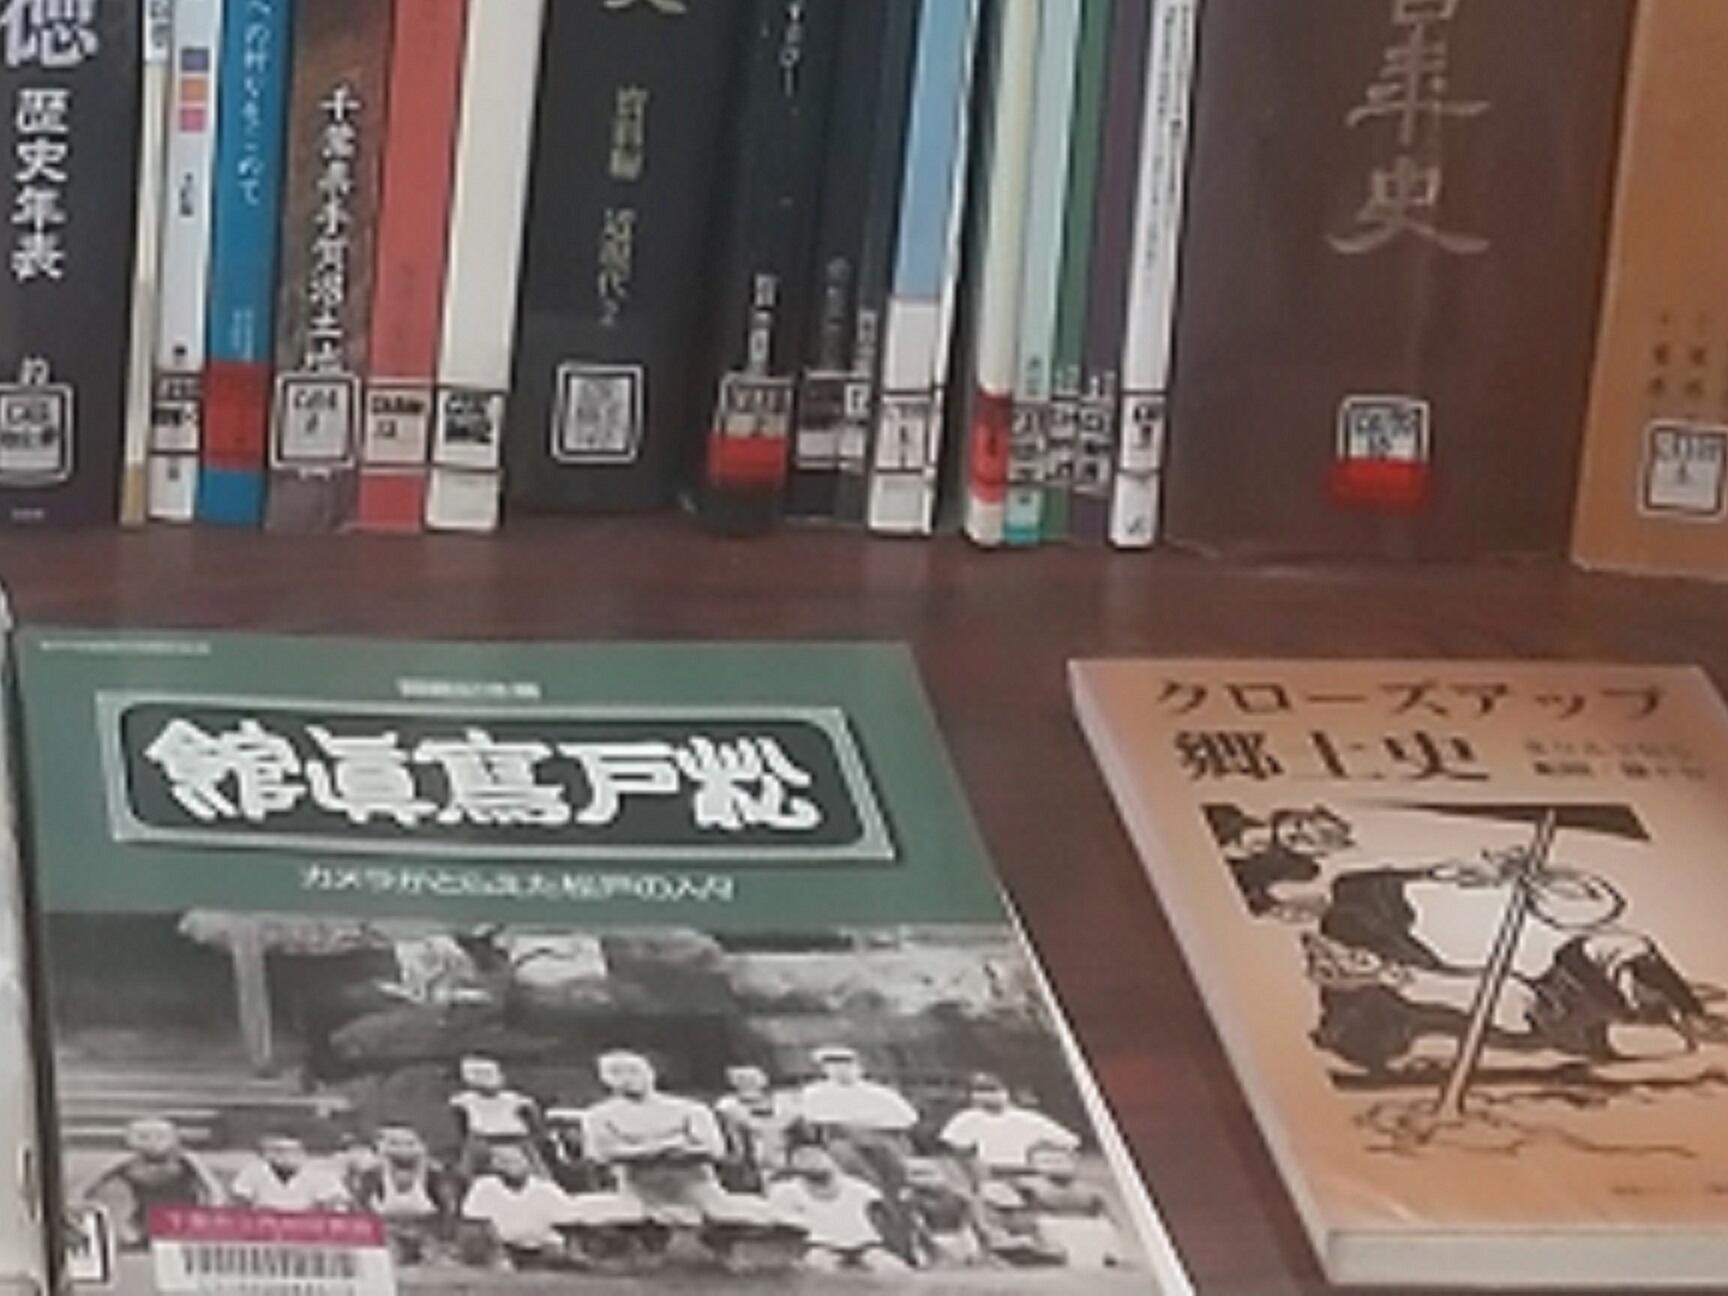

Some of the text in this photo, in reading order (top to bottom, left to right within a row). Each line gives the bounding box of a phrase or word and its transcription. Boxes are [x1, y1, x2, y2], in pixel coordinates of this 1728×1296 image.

[8, 87, 72, 282] 歴史年表
[1156, 678, 1666, 719] クローズアップ
[1173, 730, 1490, 781] 郷土史
